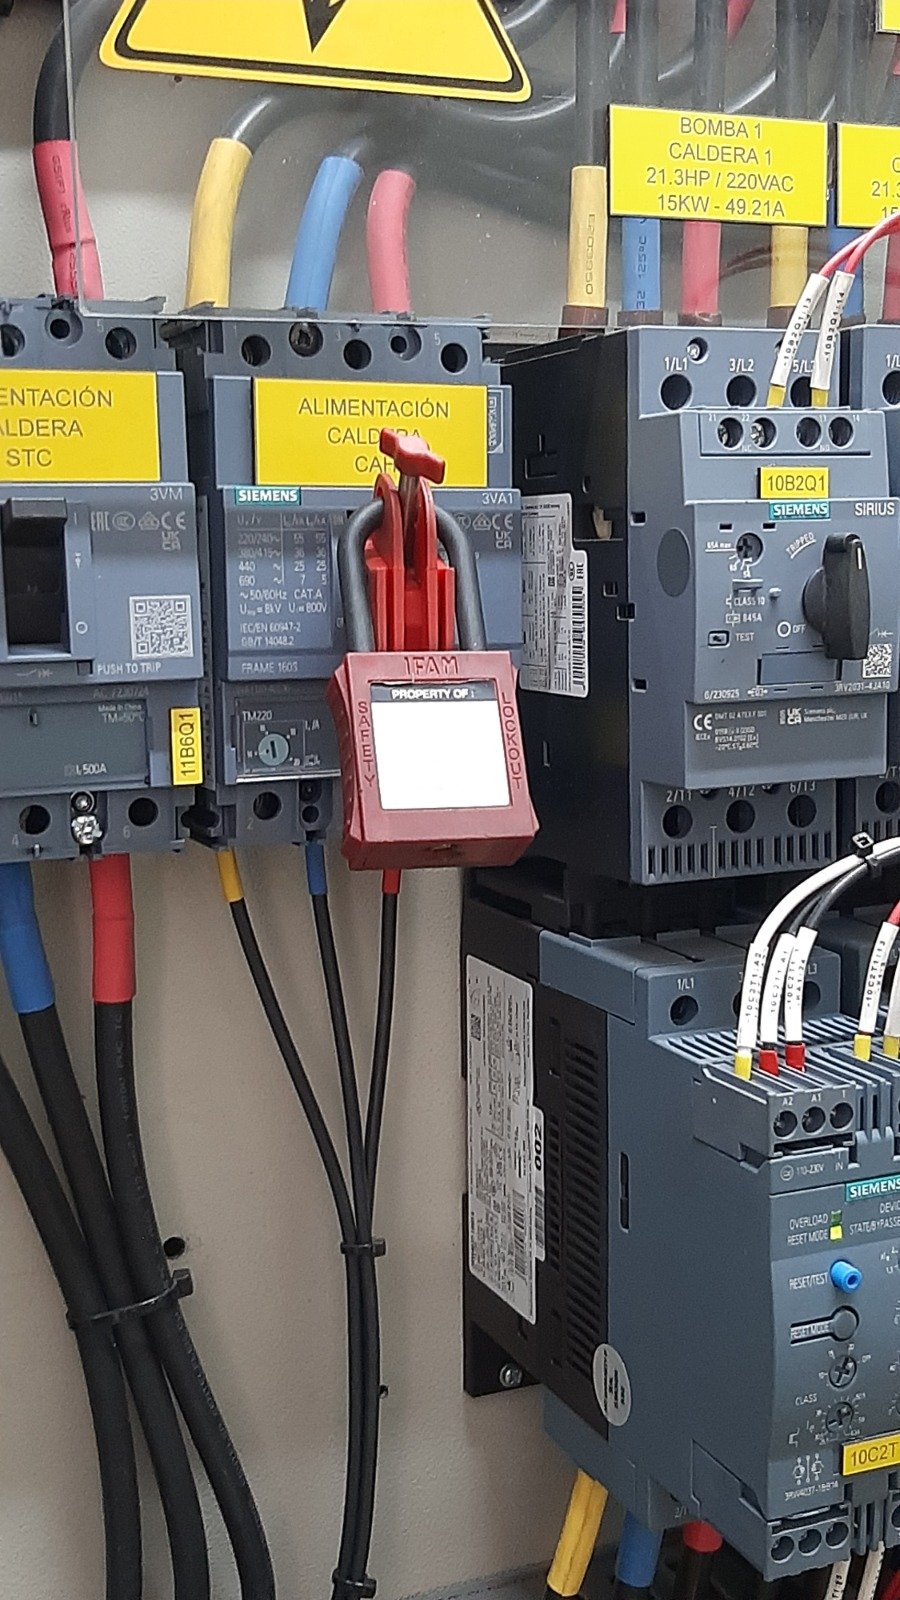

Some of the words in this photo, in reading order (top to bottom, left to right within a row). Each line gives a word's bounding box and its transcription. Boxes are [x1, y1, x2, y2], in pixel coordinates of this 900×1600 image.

[680, 116, 748, 138] BOMBA
[755, 123, 762, 139] 1
[669, 142, 758, 164] CALDERA
[764, 149, 772, 166] 1
[646, 166, 710, 188] 21.3HP
[715, 171, 722, 188] /
[726, 172, 794, 193] 220VAC
[657, 195, 710, 212] 15KW
[725, 197, 785, 217] 49.21A
[664, 356, 688, 371] 1/L1
[729, 358, 754, 373] 3/L2
[298, 397, 450, 419] ALIMENTACIÓN
[0, 418, 84, 437] LDERA
[6, 448, 53, 468] STC
[767, 475, 825, 491] 10B2Q1
[150, 488, 183, 501] 3VM
[237, 489, 298, 502] SIEMENS
[482, 492, 513, 505] 3VA1
[773, 503, 828, 515] SIEMENS
[854, 502, 895, 516] SIRIUS
[785, 531, 815, 555] TRIPPED
[238, 561, 256, 572] 440
[294, 560, 305, 572] 25
[316, 560, 327, 572] 25
[238, 576, 256, 586] 690
[734, 597, 756, 606] CLASS
[736, 632, 754, 641] TEST
[97, 662, 124, 675] PUSH
[126, 662, 139, 673] TO
[141, 661, 162, 673] TRIP
[241, 663, 275, 674] FRAME
[391, 688, 451, 699] PROPERTY
[242, 710, 273, 722] TM220
[179, 712, 196, 776] 11B6Q1
[357, 701, 376, 787] SAFETY
[501, 692, 522, 789] LOCKOUT
[728, 784, 755, 797] 4/T2
[790, 780, 816, 793] 6/T3
[666, 790, 692, 803] 2/T1
[676, 978, 695, 990] 1/L1
[810, 1092, 822, 1102] A1
[533, 1123, 543, 1171] 002
[789, 1213, 829, 1231] OVERLOAD
[787, 1232, 808, 1246] RESET
[808, 1228, 829, 1242] MODE
[789, 1271, 829, 1291] RESET/TEST
[795, 1393, 818, 1406] CLASS
